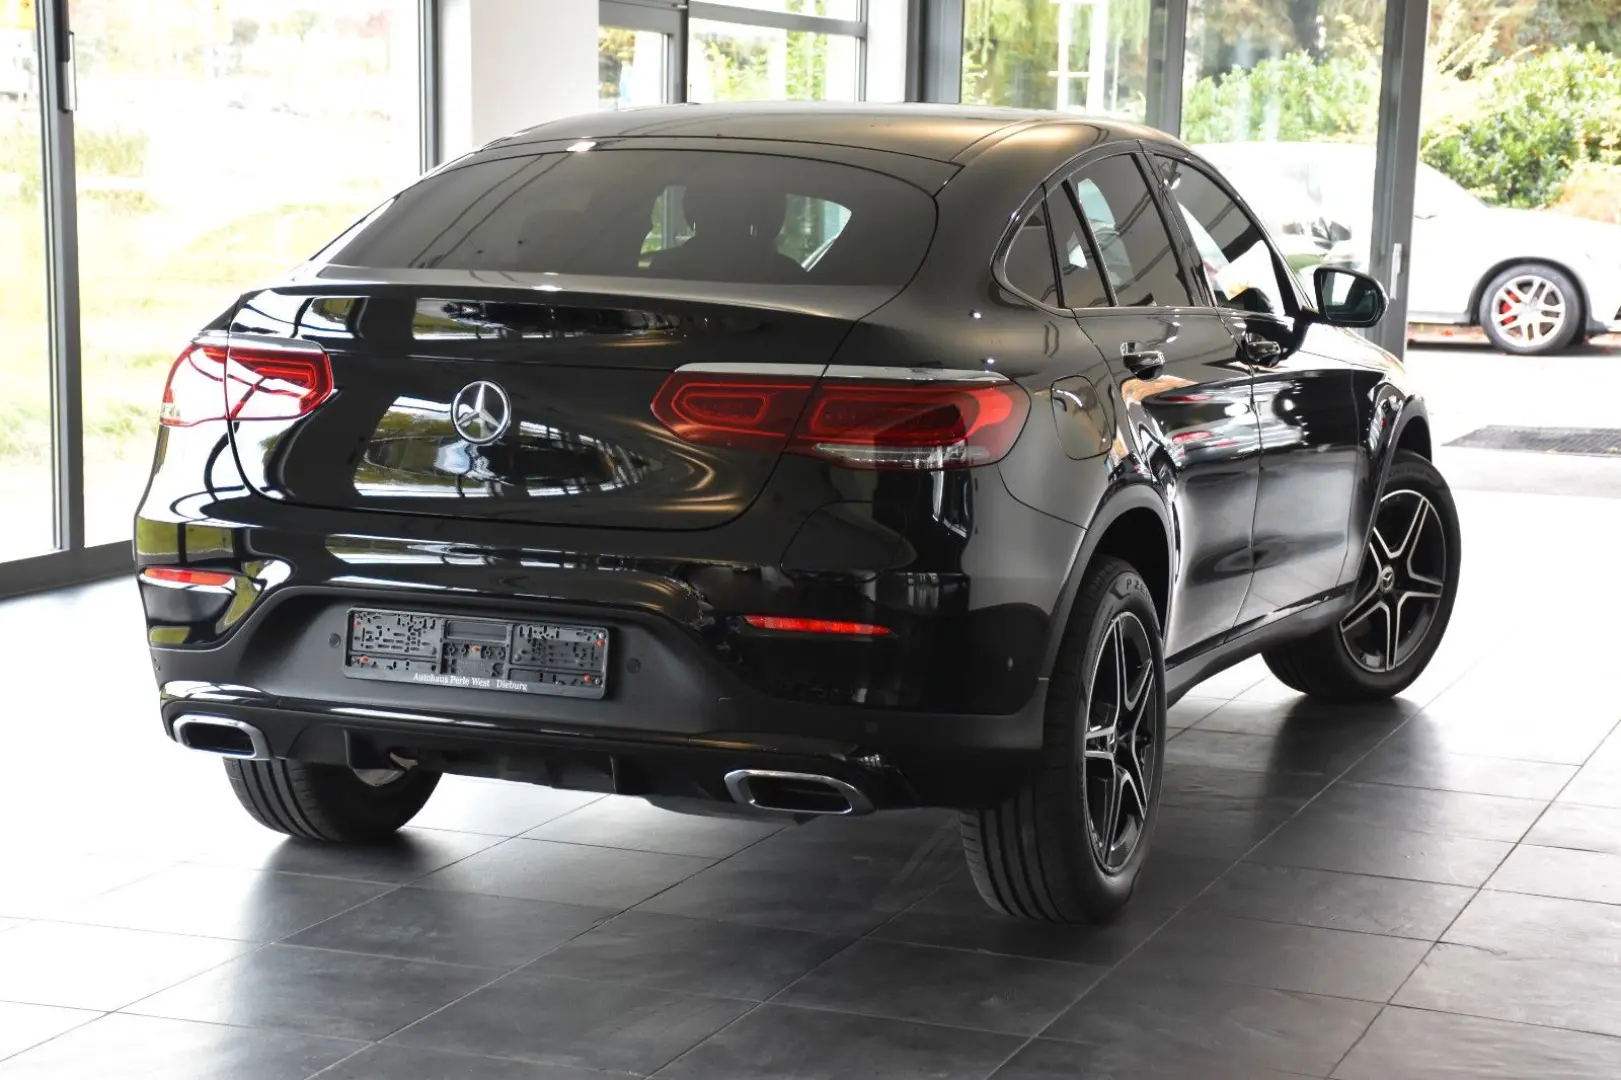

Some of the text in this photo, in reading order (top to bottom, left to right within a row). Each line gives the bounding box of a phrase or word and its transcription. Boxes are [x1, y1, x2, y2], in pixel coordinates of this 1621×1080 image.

[413, 673, 527, 692] Autohaus Perle West Dieburg
